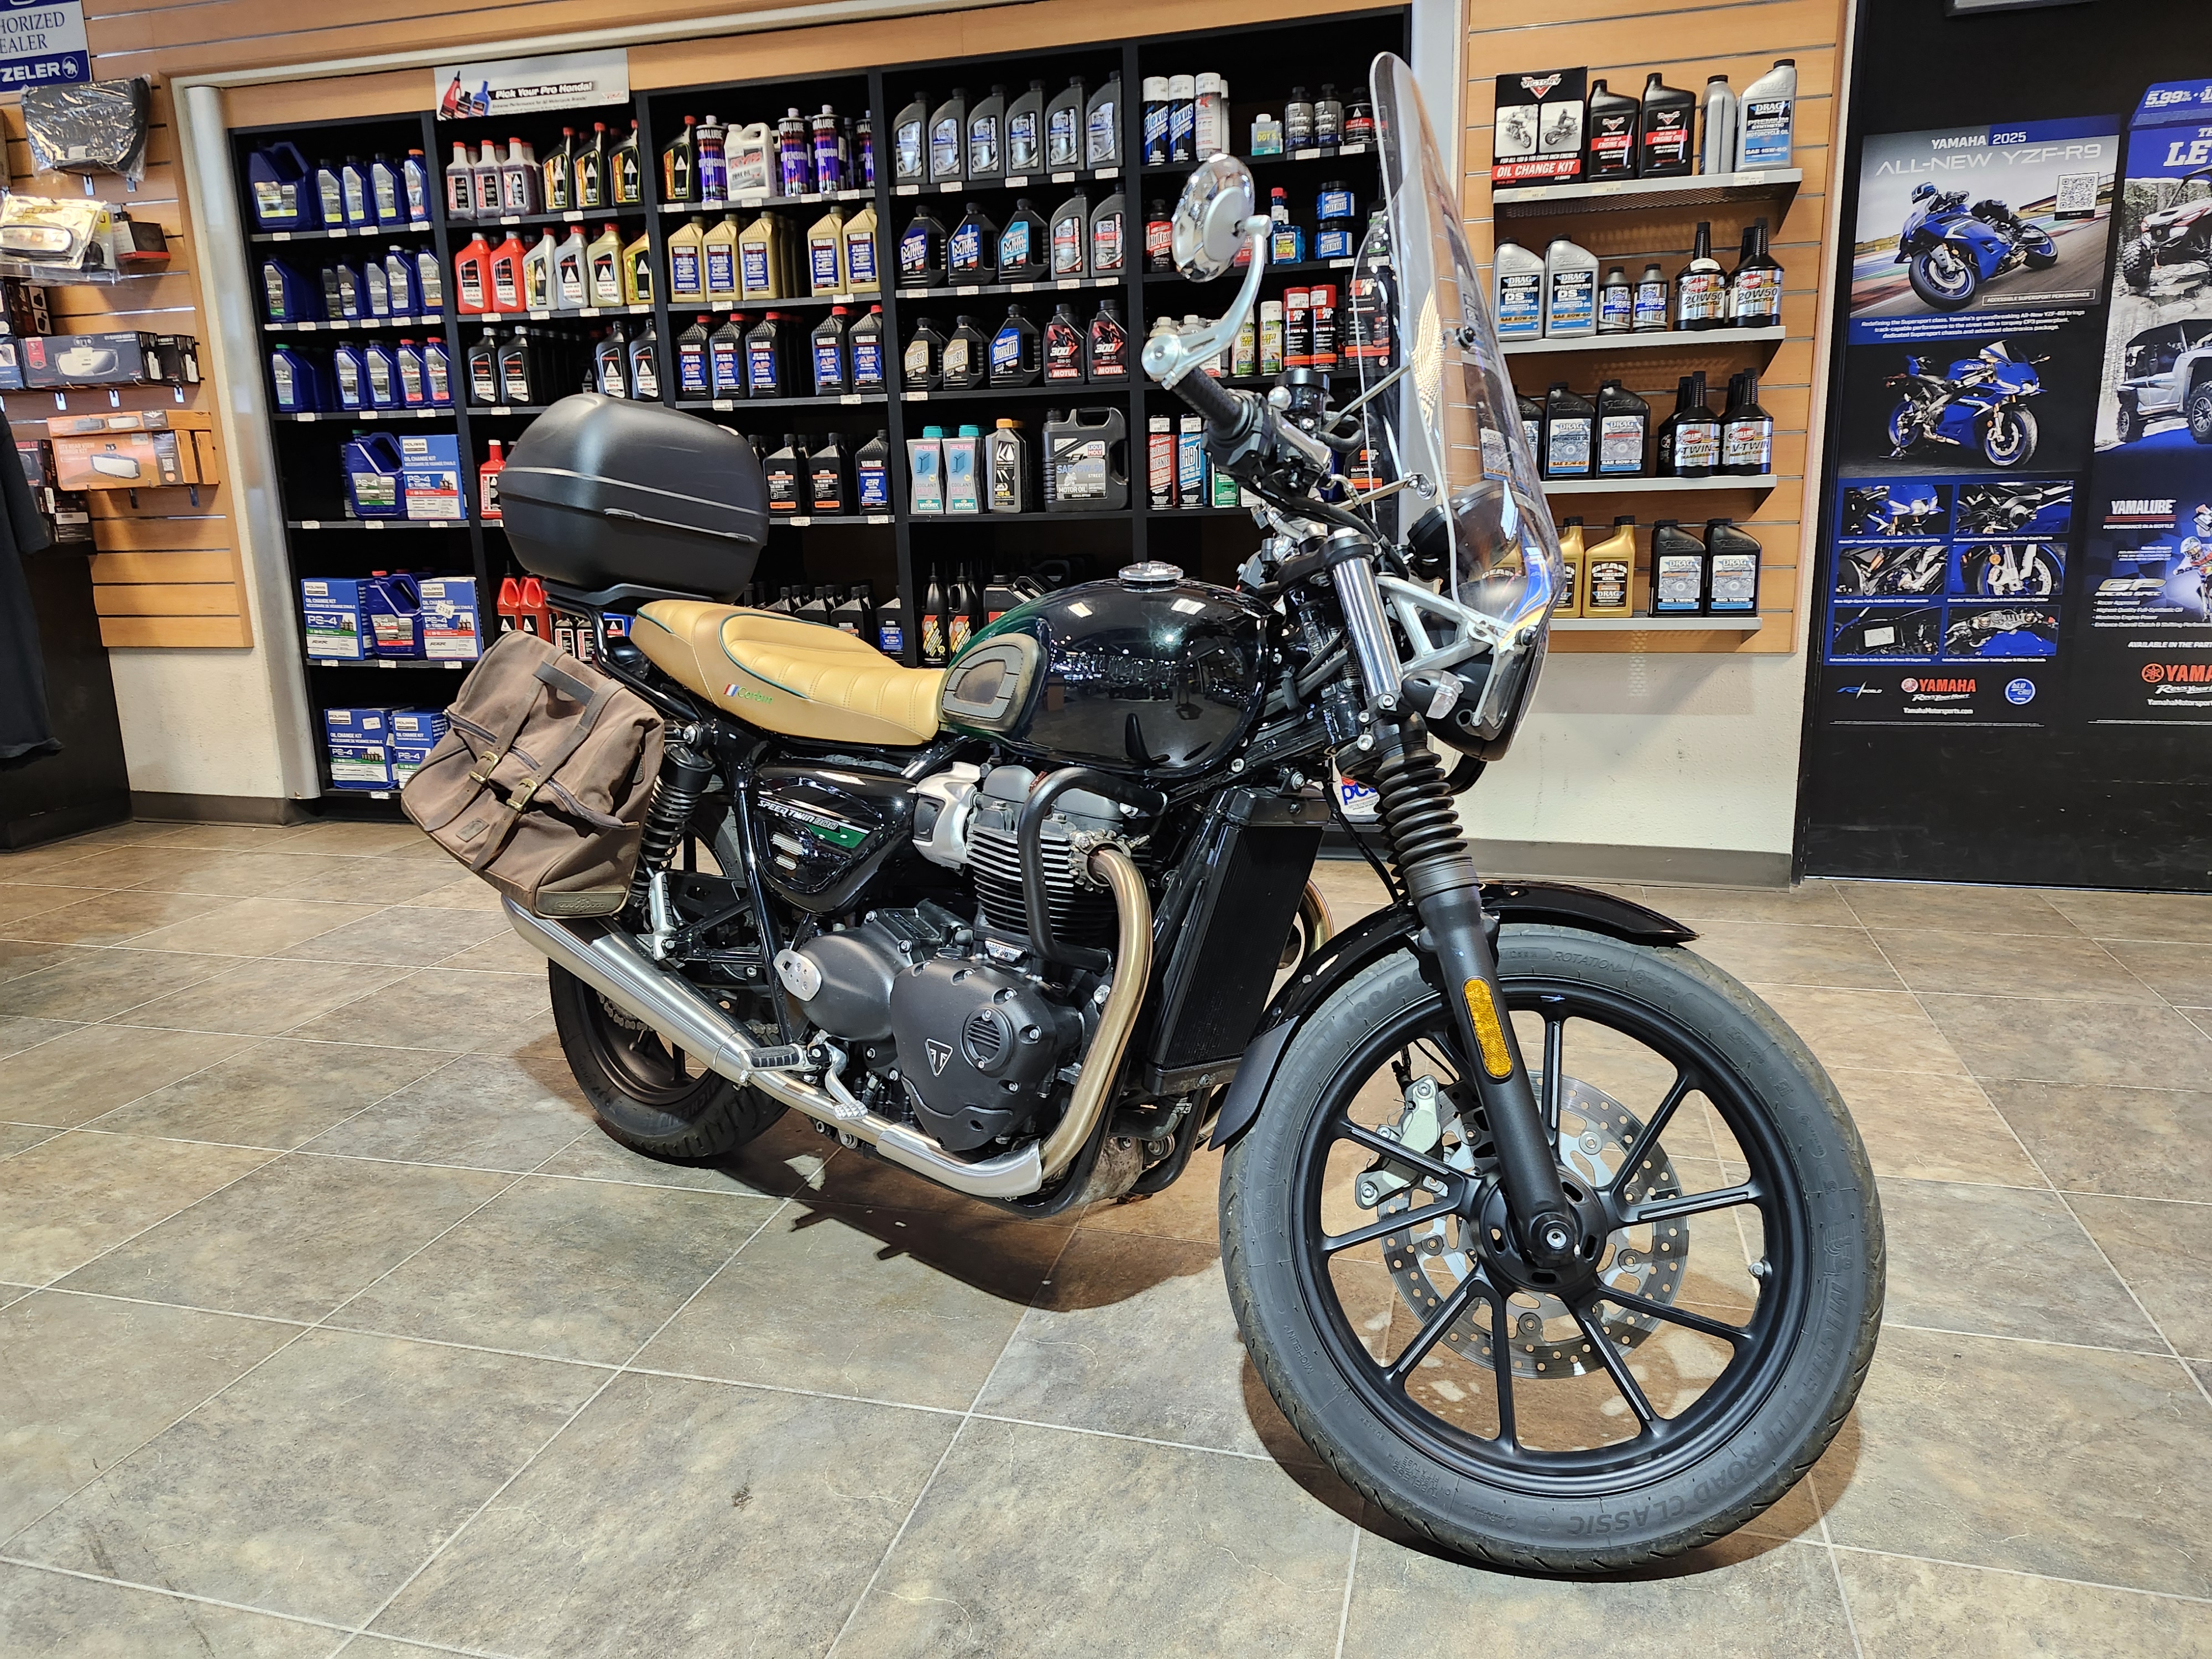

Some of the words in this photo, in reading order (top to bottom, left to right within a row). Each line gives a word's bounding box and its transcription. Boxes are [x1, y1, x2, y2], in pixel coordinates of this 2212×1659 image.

[495, 89, 515, 99] Pick
[518, 87, 539, 98] Your
[541, 85, 558, 95] Pro
[559, 82, 592, 93] Honda!
[1756, 103, 1783, 112] DRAG
[1144, 105, 1168, 136] Plexus
[1169, 103, 1193, 135] Plexus
[1748, 117, 1789, 126] PREMIUM
[1931, 135, 1987, 150] YAMAHA
[1992, 131, 2027, 145] 2025
[1875, 153, 1993, 177] ALL-NEW
[2001, 143, 2102, 165] YZF-R9
[1496, 166, 1512, 178] OIL
[1515, 162, 1554, 176] CHANGE
[1557, 161, 1575, 172] KIT
[1554, 283, 1592, 291] PREMIUM
[1738, 287, 1777, 301] 20W50
[1685, 291, 1723, 305] 20W50
[1050, 340, 1078, 357] 300V
[1095, 338, 1123, 353] 300V
[1052, 369, 1077, 377] MOTUL
[1098, 367, 1123, 375] MOTUL
[1674, 444, 1712, 456] V-TWIN
[1732, 441, 1769, 452] V-TWIN
[1180, 447, 1194, 467] FAB
[2111, 499, 2177, 514] YAMALUBE
[1481, 567, 1515, 579] GEAR
[1592, 562, 1627, 573] GEAR
[2099, 578, 2167, 591] GP
[437, 606, 451, 615] Z138
[307, 615, 337, 625] PS-4
[1919, 679, 1976, 692] YAMAHA
[737, 686, 774, 705] Corbin
[1903, 707, 1973, 715] YamahaMotorsports.com
[757, 800, 788, 817] SPEED
[788, 808, 815, 824] TWIN
[812, 817, 839, 830] 900
[1552, 951, 1620, 972] ROTATION
[1692, 1444, 1764, 1504] ROAD
[1566, 1495, 1686, 1536] CLASSIC
